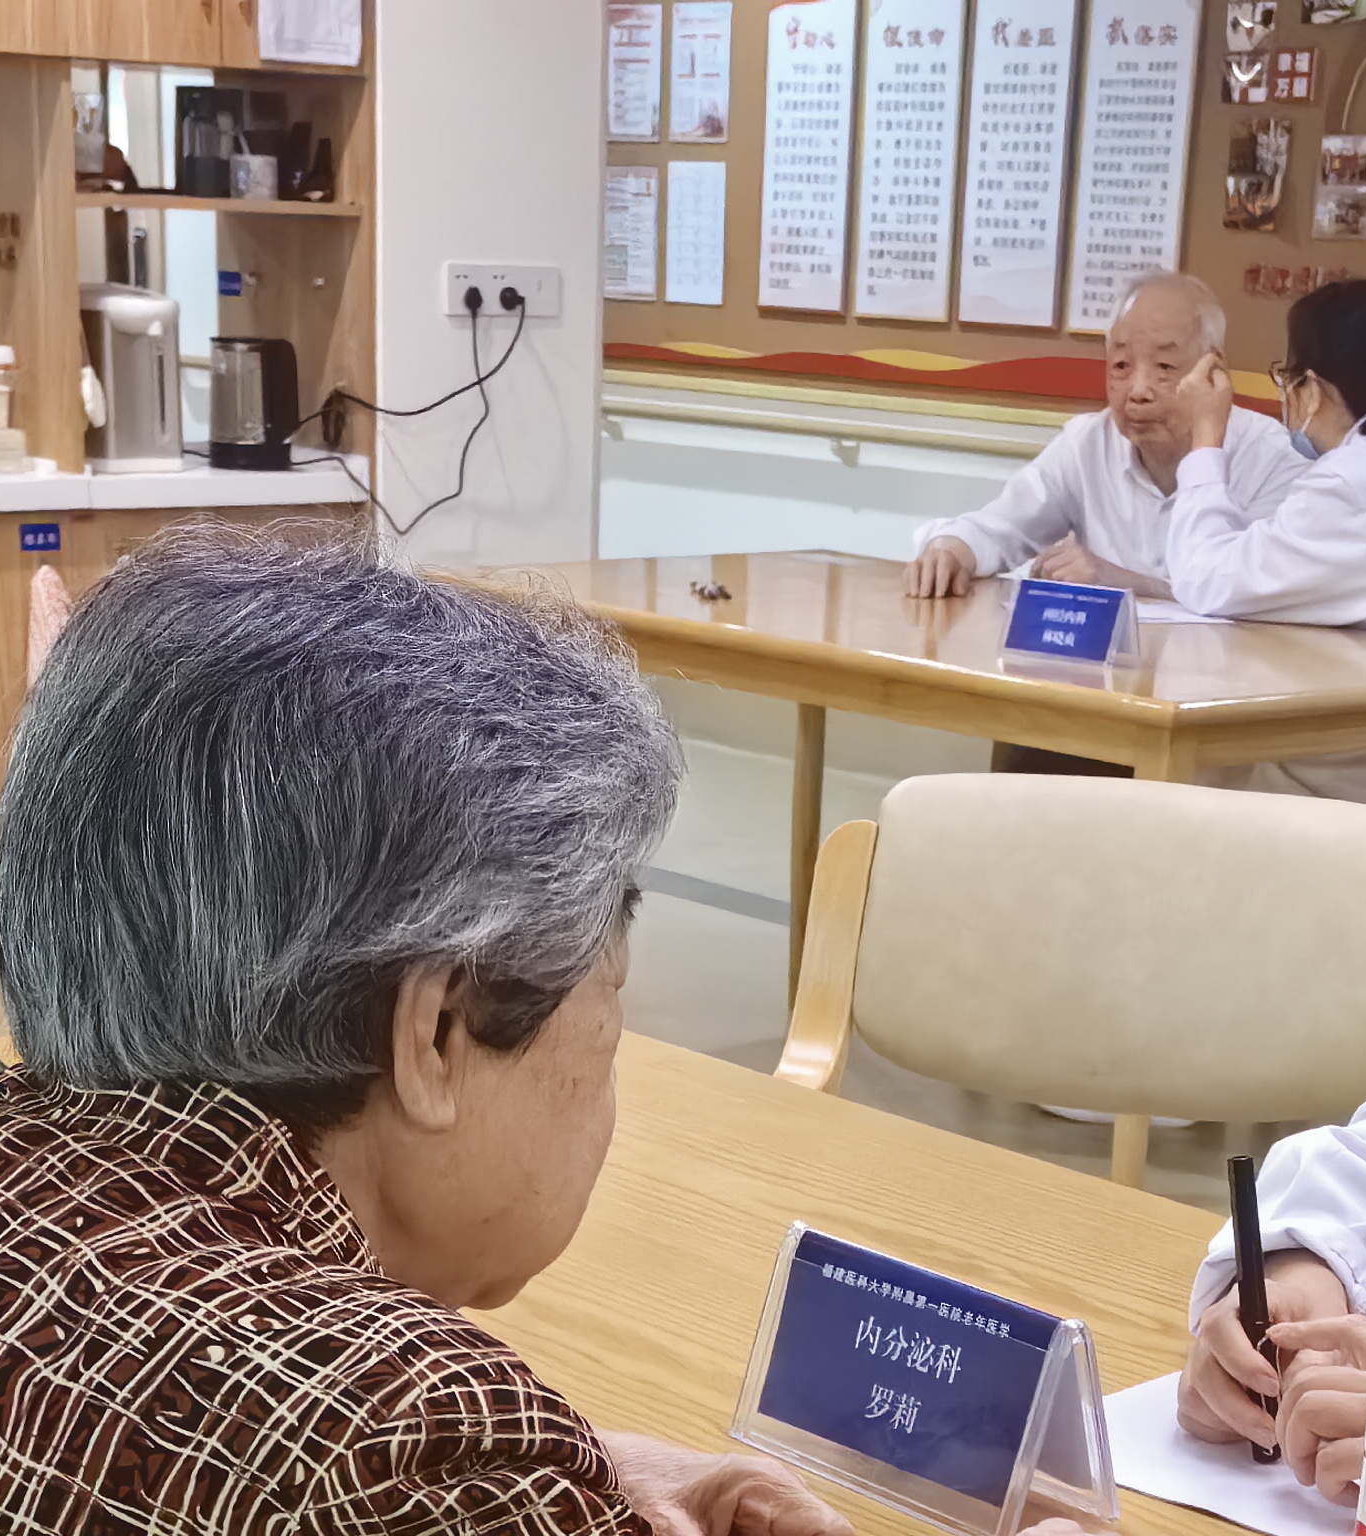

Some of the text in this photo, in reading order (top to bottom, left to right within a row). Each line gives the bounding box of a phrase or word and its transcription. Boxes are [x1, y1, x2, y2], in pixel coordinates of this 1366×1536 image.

[855, 1315, 962, 1384] 内分泌科
[864, 1383, 922, 1434] 罗莉
